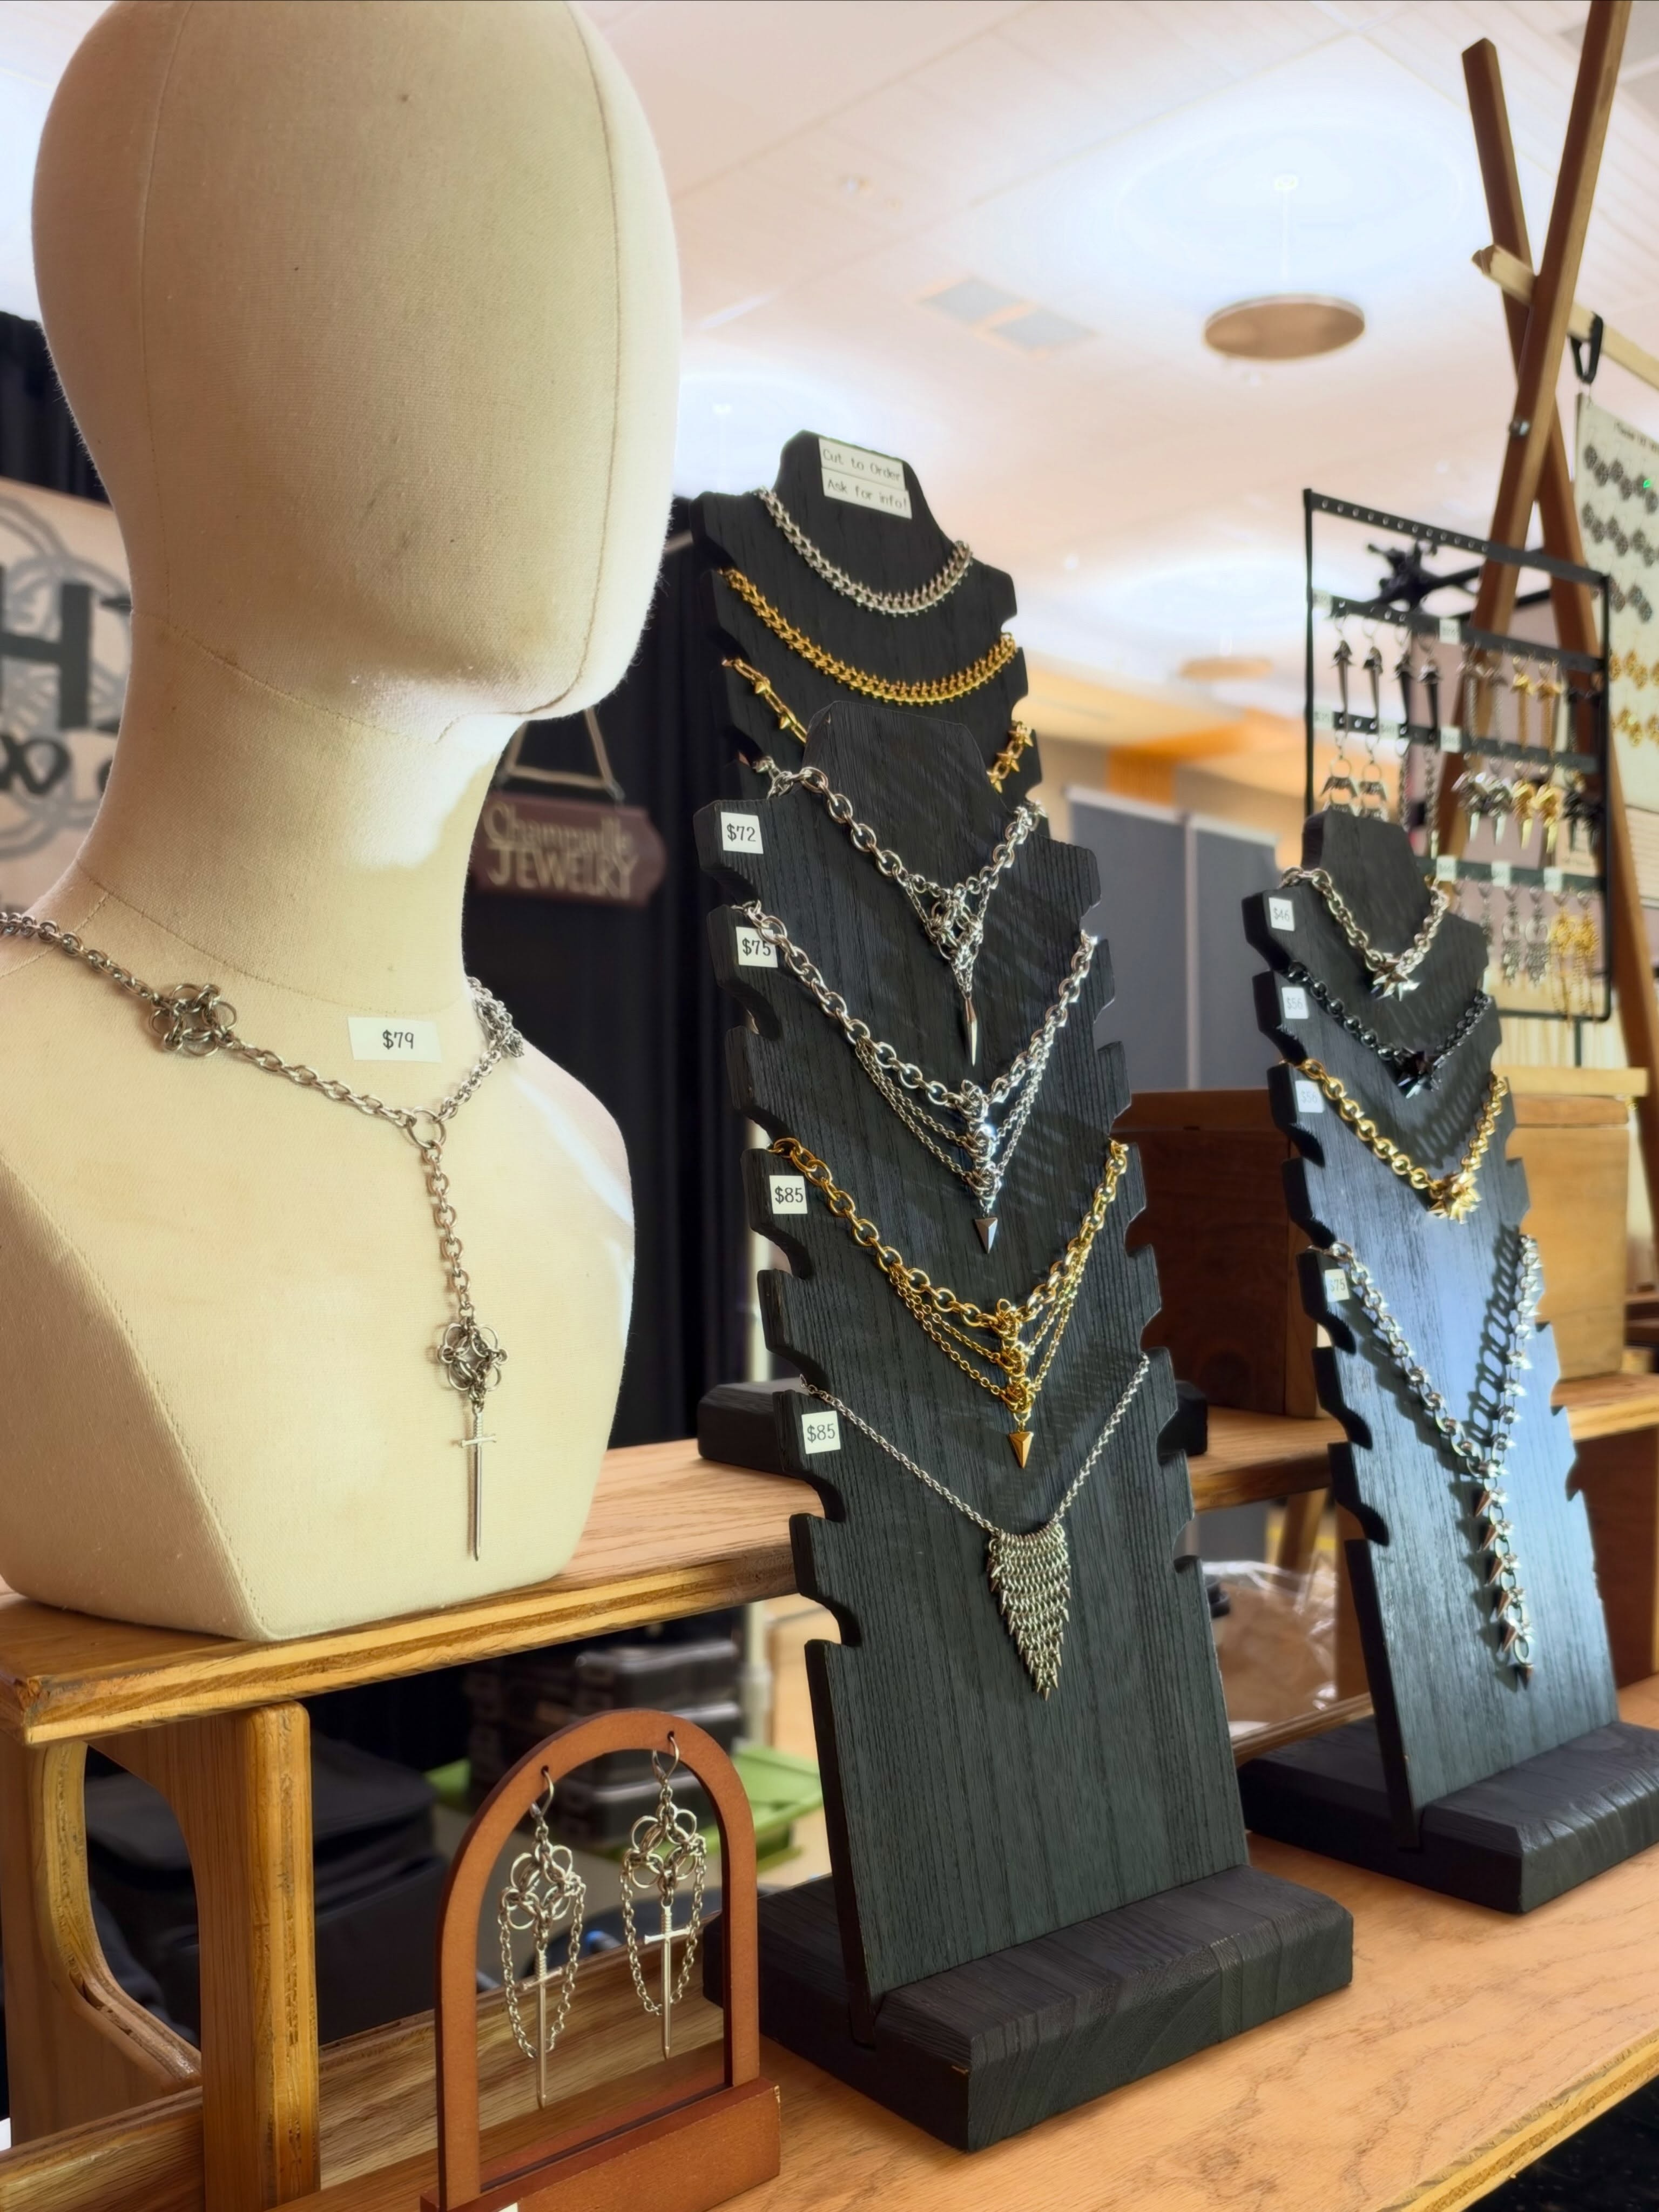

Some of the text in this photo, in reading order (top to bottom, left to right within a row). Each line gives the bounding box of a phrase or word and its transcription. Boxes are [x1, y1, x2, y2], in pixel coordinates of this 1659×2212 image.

[822, 449, 901, 482] Cut to Order
[827, 479, 907, 510] Ask for info!
[726, 823, 757, 842] $72
[487, 840, 639, 900] JEWELRY
[1273, 907, 1290, 922] $46
[742, 937, 771, 956] $75
[1286, 996, 1303, 1010] $56
[382, 1029, 414, 1050] $79
[774, 1185, 804, 1204] $85
[1330, 1278, 1346, 1292] $75
[807, 1423, 835, 1443] $85
